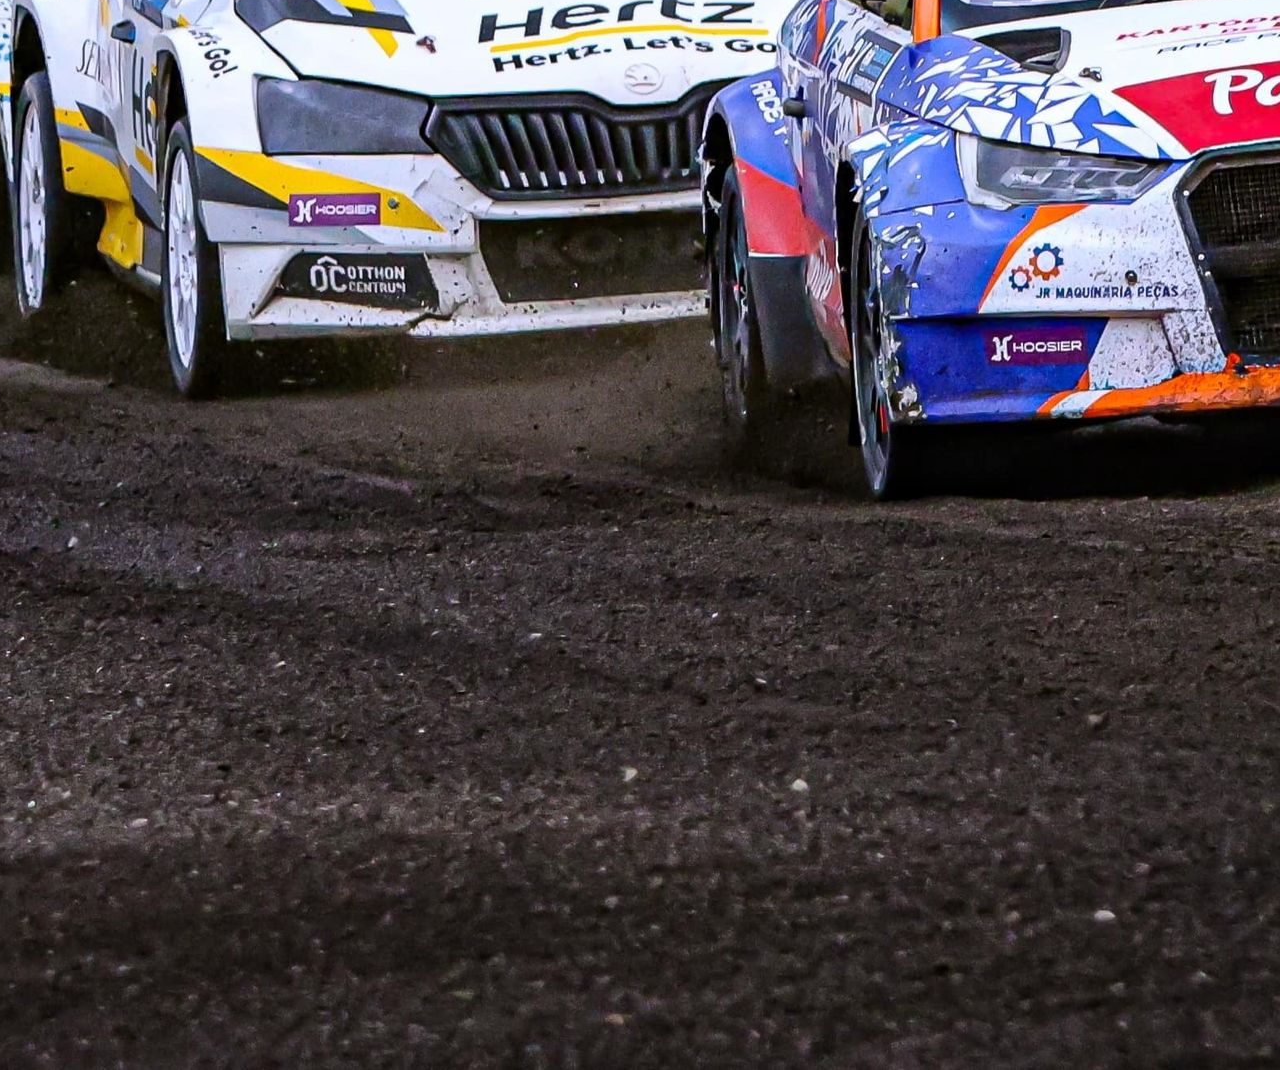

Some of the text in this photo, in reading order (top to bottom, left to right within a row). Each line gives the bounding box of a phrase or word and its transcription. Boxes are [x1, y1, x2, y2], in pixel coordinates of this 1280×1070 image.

[493, 42, 612, 72] Hertz.
[623, 36, 714, 53] Let's
[315, 204, 377, 216] HOOSIER
[347, 265, 406, 281] OTTHON
[348, 281, 406, 293] CENTRUM
[1012, 339, 1083, 353] HOOSIER
